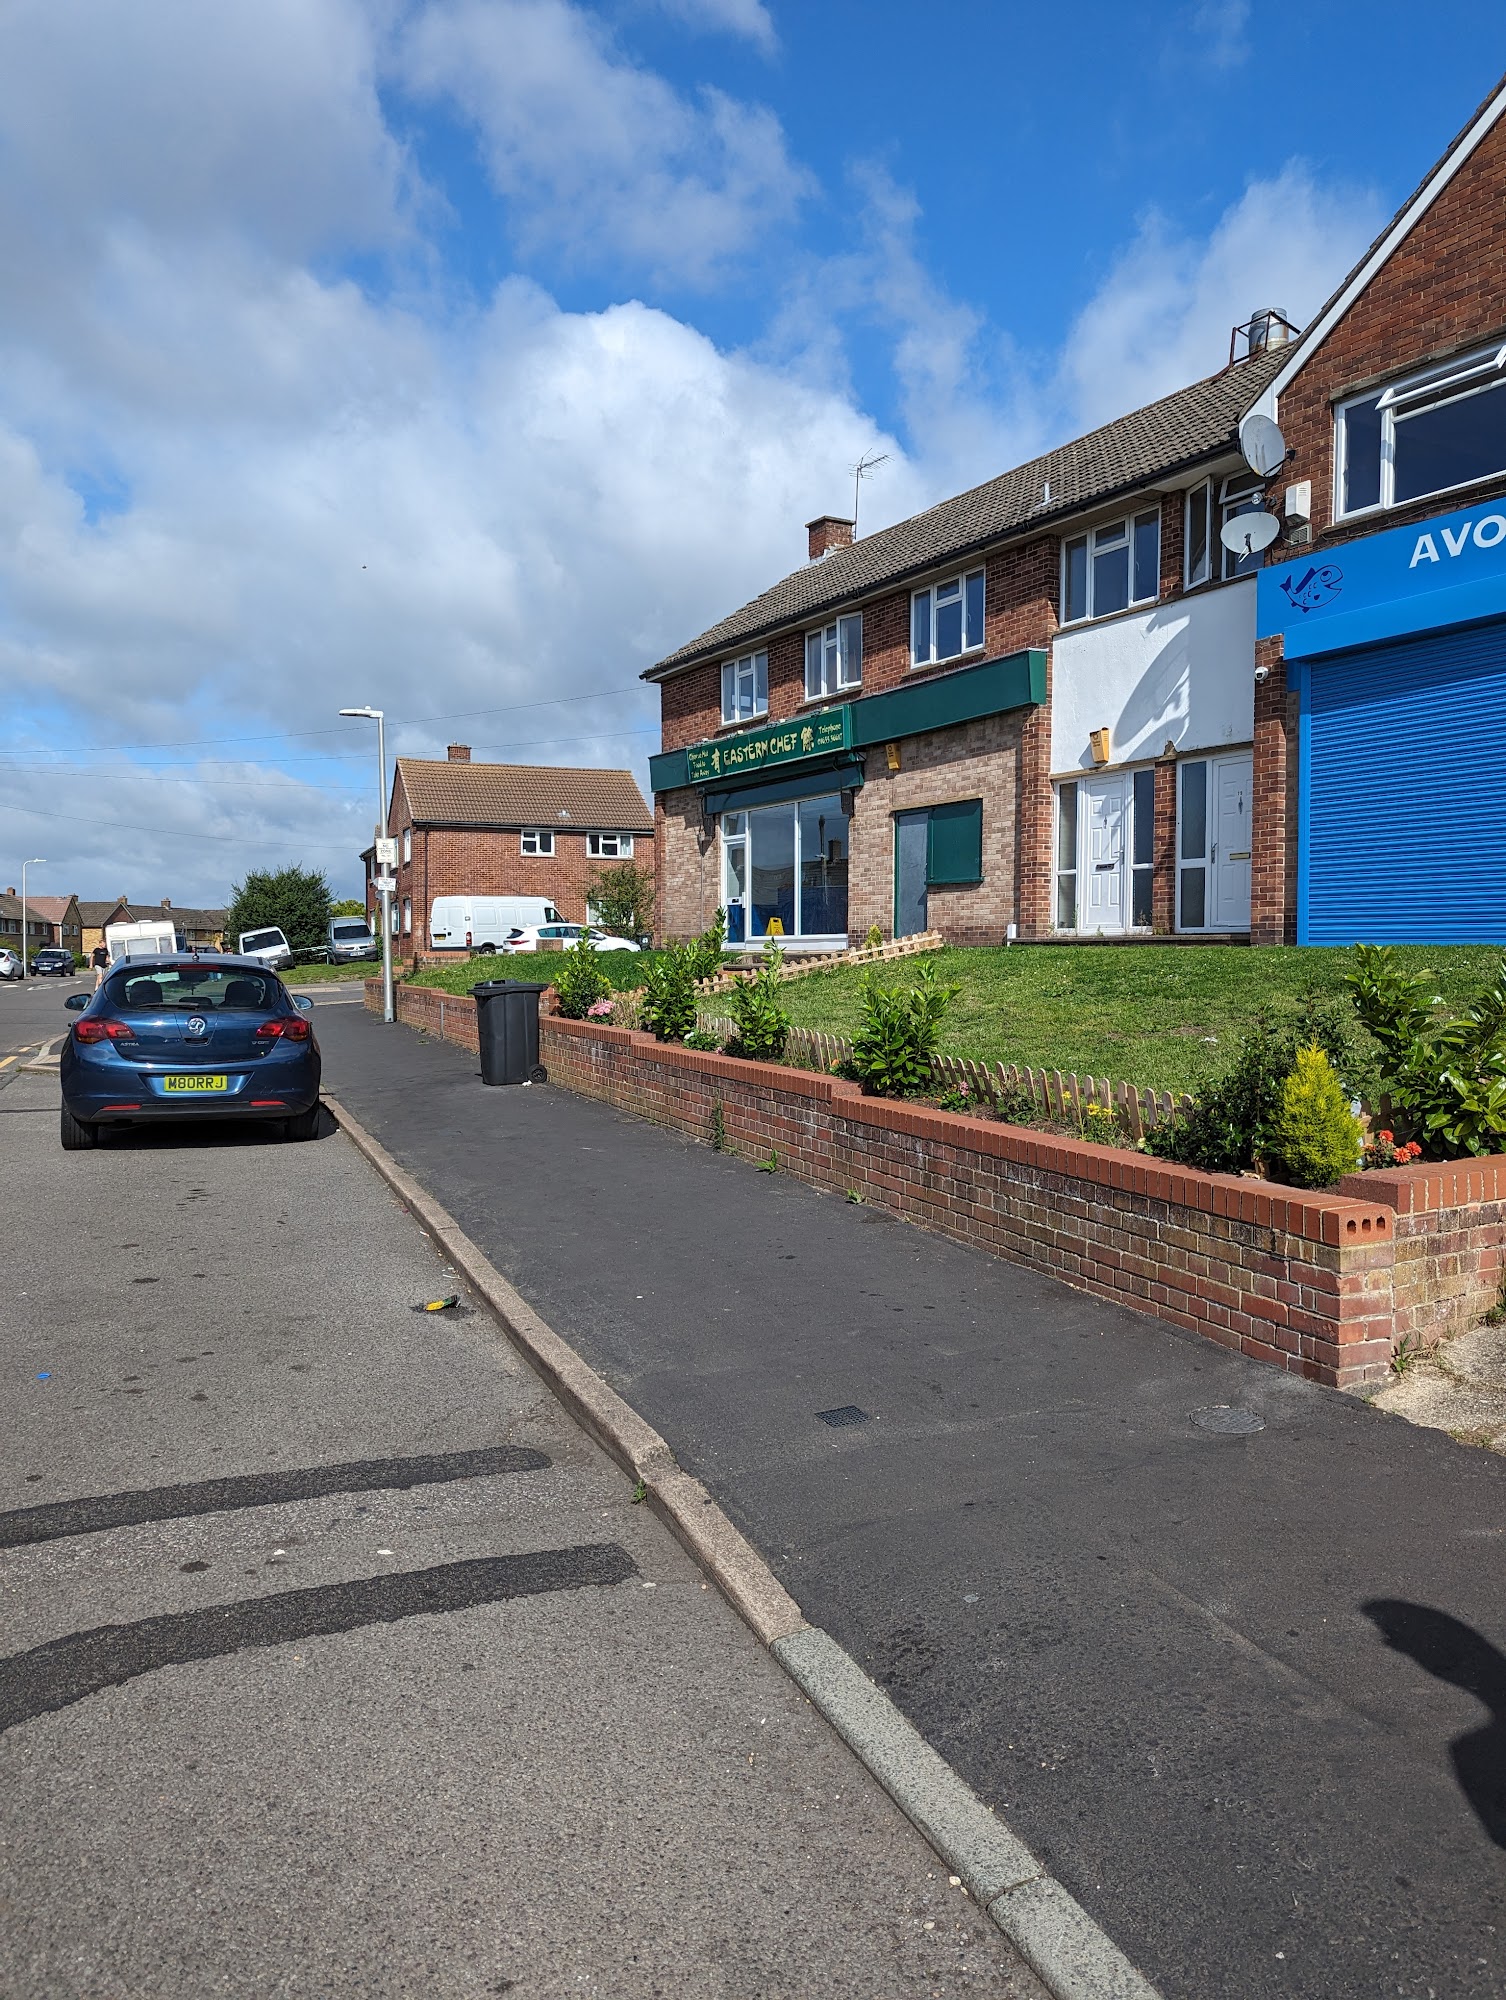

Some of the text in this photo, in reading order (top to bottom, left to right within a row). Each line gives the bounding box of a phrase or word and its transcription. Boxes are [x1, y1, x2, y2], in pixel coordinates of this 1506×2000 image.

[1408, 514, 1506, 569] AVO
[818, 723, 841, 735] Telephone
[724, 732, 797, 765] EASTERN CHEF
[168, 1077, 223, 1089] M80RRJ
